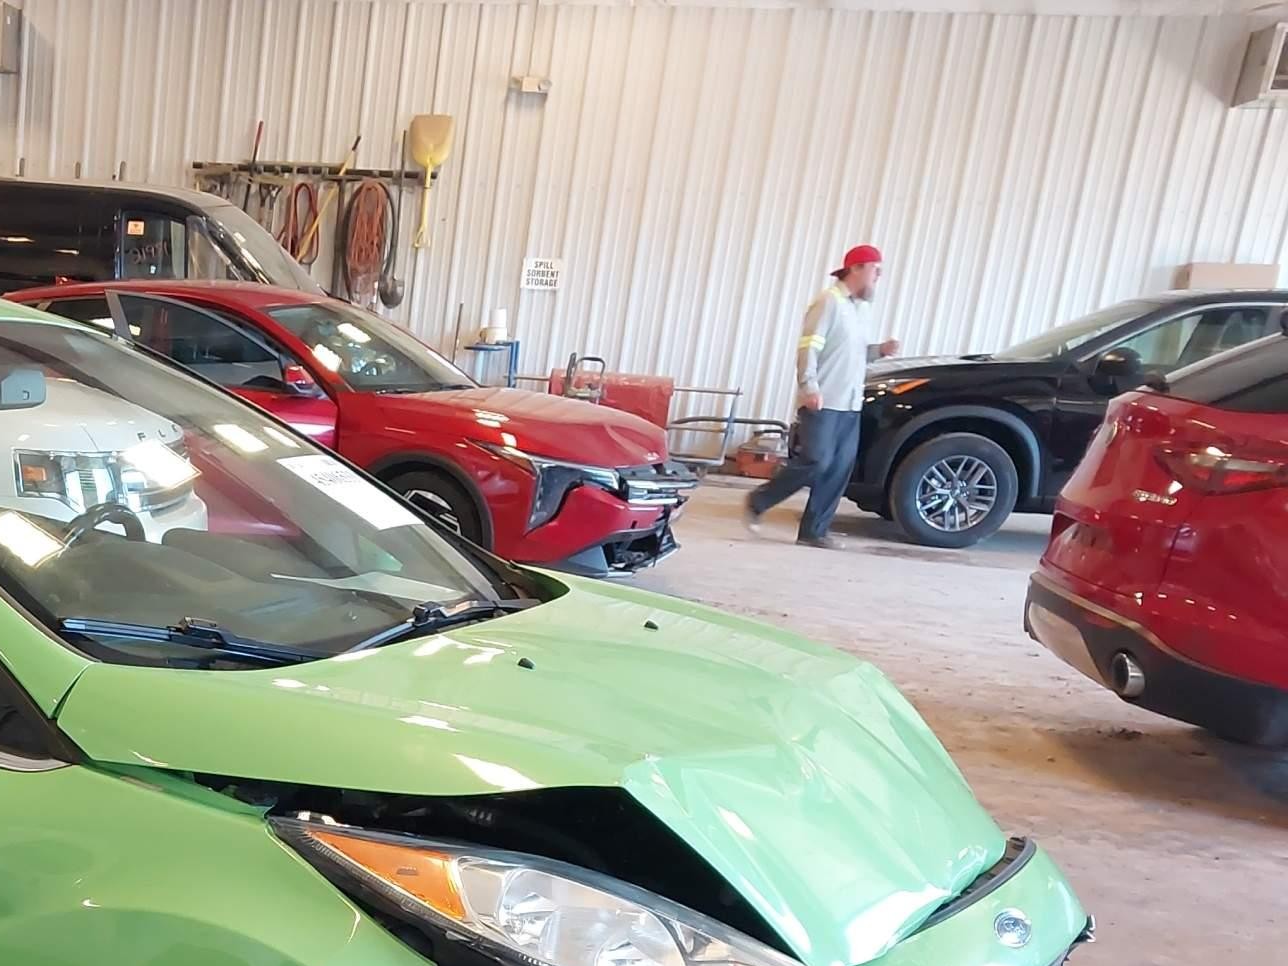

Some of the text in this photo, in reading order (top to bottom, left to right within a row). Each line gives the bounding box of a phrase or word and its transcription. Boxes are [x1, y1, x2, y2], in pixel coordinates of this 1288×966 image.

[534, 261, 553, 269] SPILL
[527, 269, 559, 278] SORBENT
[526, 278, 558, 287] STORAGE
